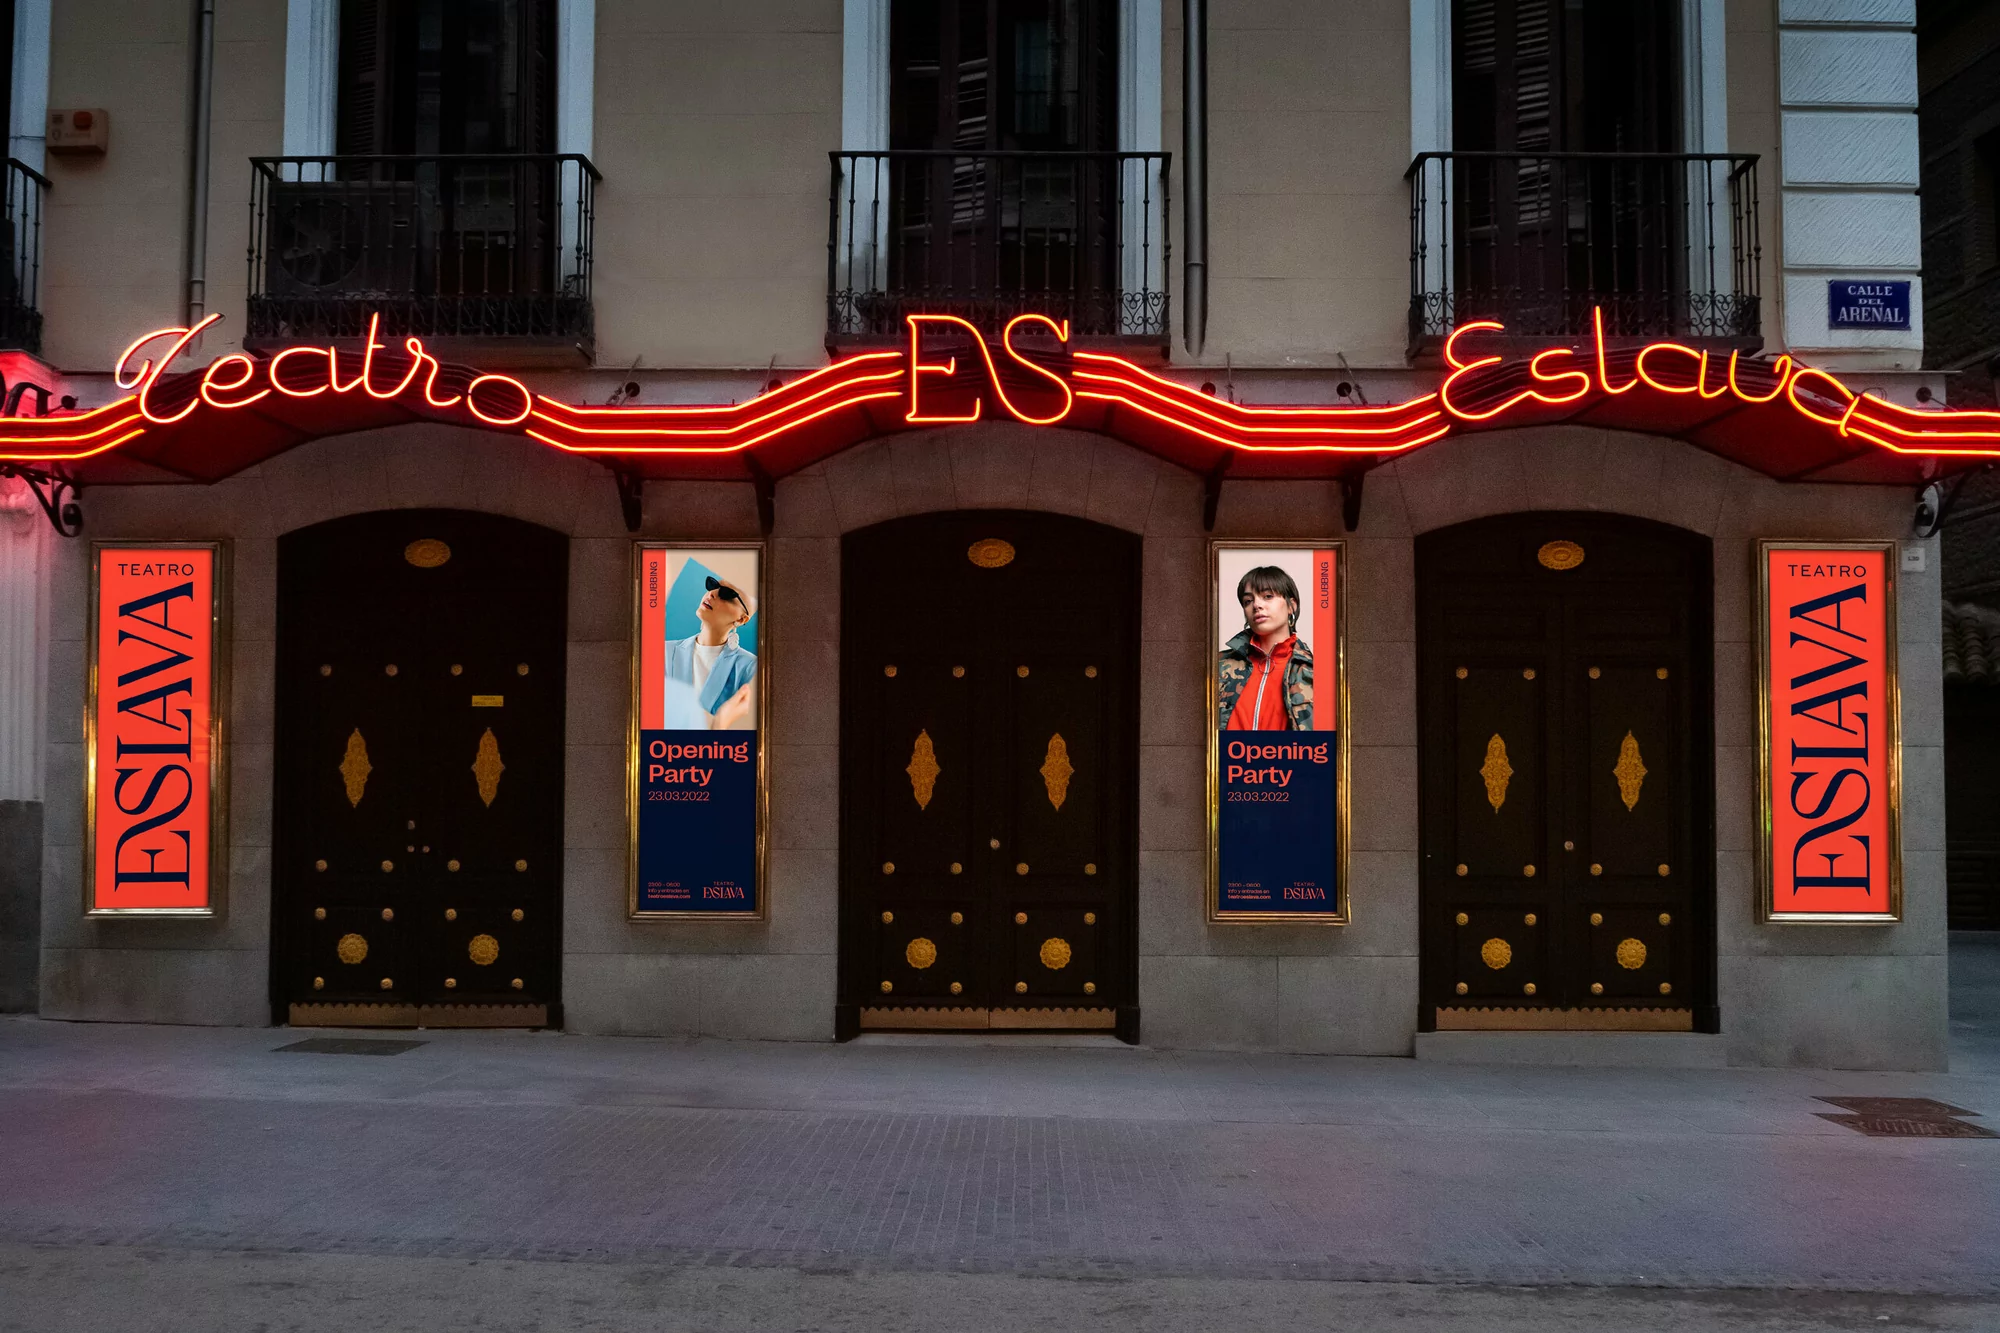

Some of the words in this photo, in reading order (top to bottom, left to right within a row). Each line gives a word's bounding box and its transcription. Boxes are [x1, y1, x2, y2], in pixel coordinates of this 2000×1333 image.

[1847, 285, 1893, 296] CALLE
[1837, 306, 1904, 323] ARENAL
[115, 312, 532, 425] Teatro
[905, 313, 1073, 425] ES
[1440, 305, 1863, 438] Eslava
[118, 563, 194, 576] TEATRO
[1788, 564, 1866, 577] TEATRO
[649, 561, 658, 608] CLUBBING
[1320, 561, 1329, 609] CLUBBING
[114, 582, 194, 892] ESLAVA
[1790, 583, 1870, 896] ESLAVA
[649, 740, 749, 763] Opening
[1227, 741, 1329, 764] Opening
[649, 764, 713, 787] Party
[1227, 765, 1293, 787] Party
[648, 790, 710, 801] 23.03.2022
[1227, 791, 1290, 802] 23.03.2022
[703, 886, 745, 899] ESLAVA
[1283, 887, 1326, 900] ESLAVA
